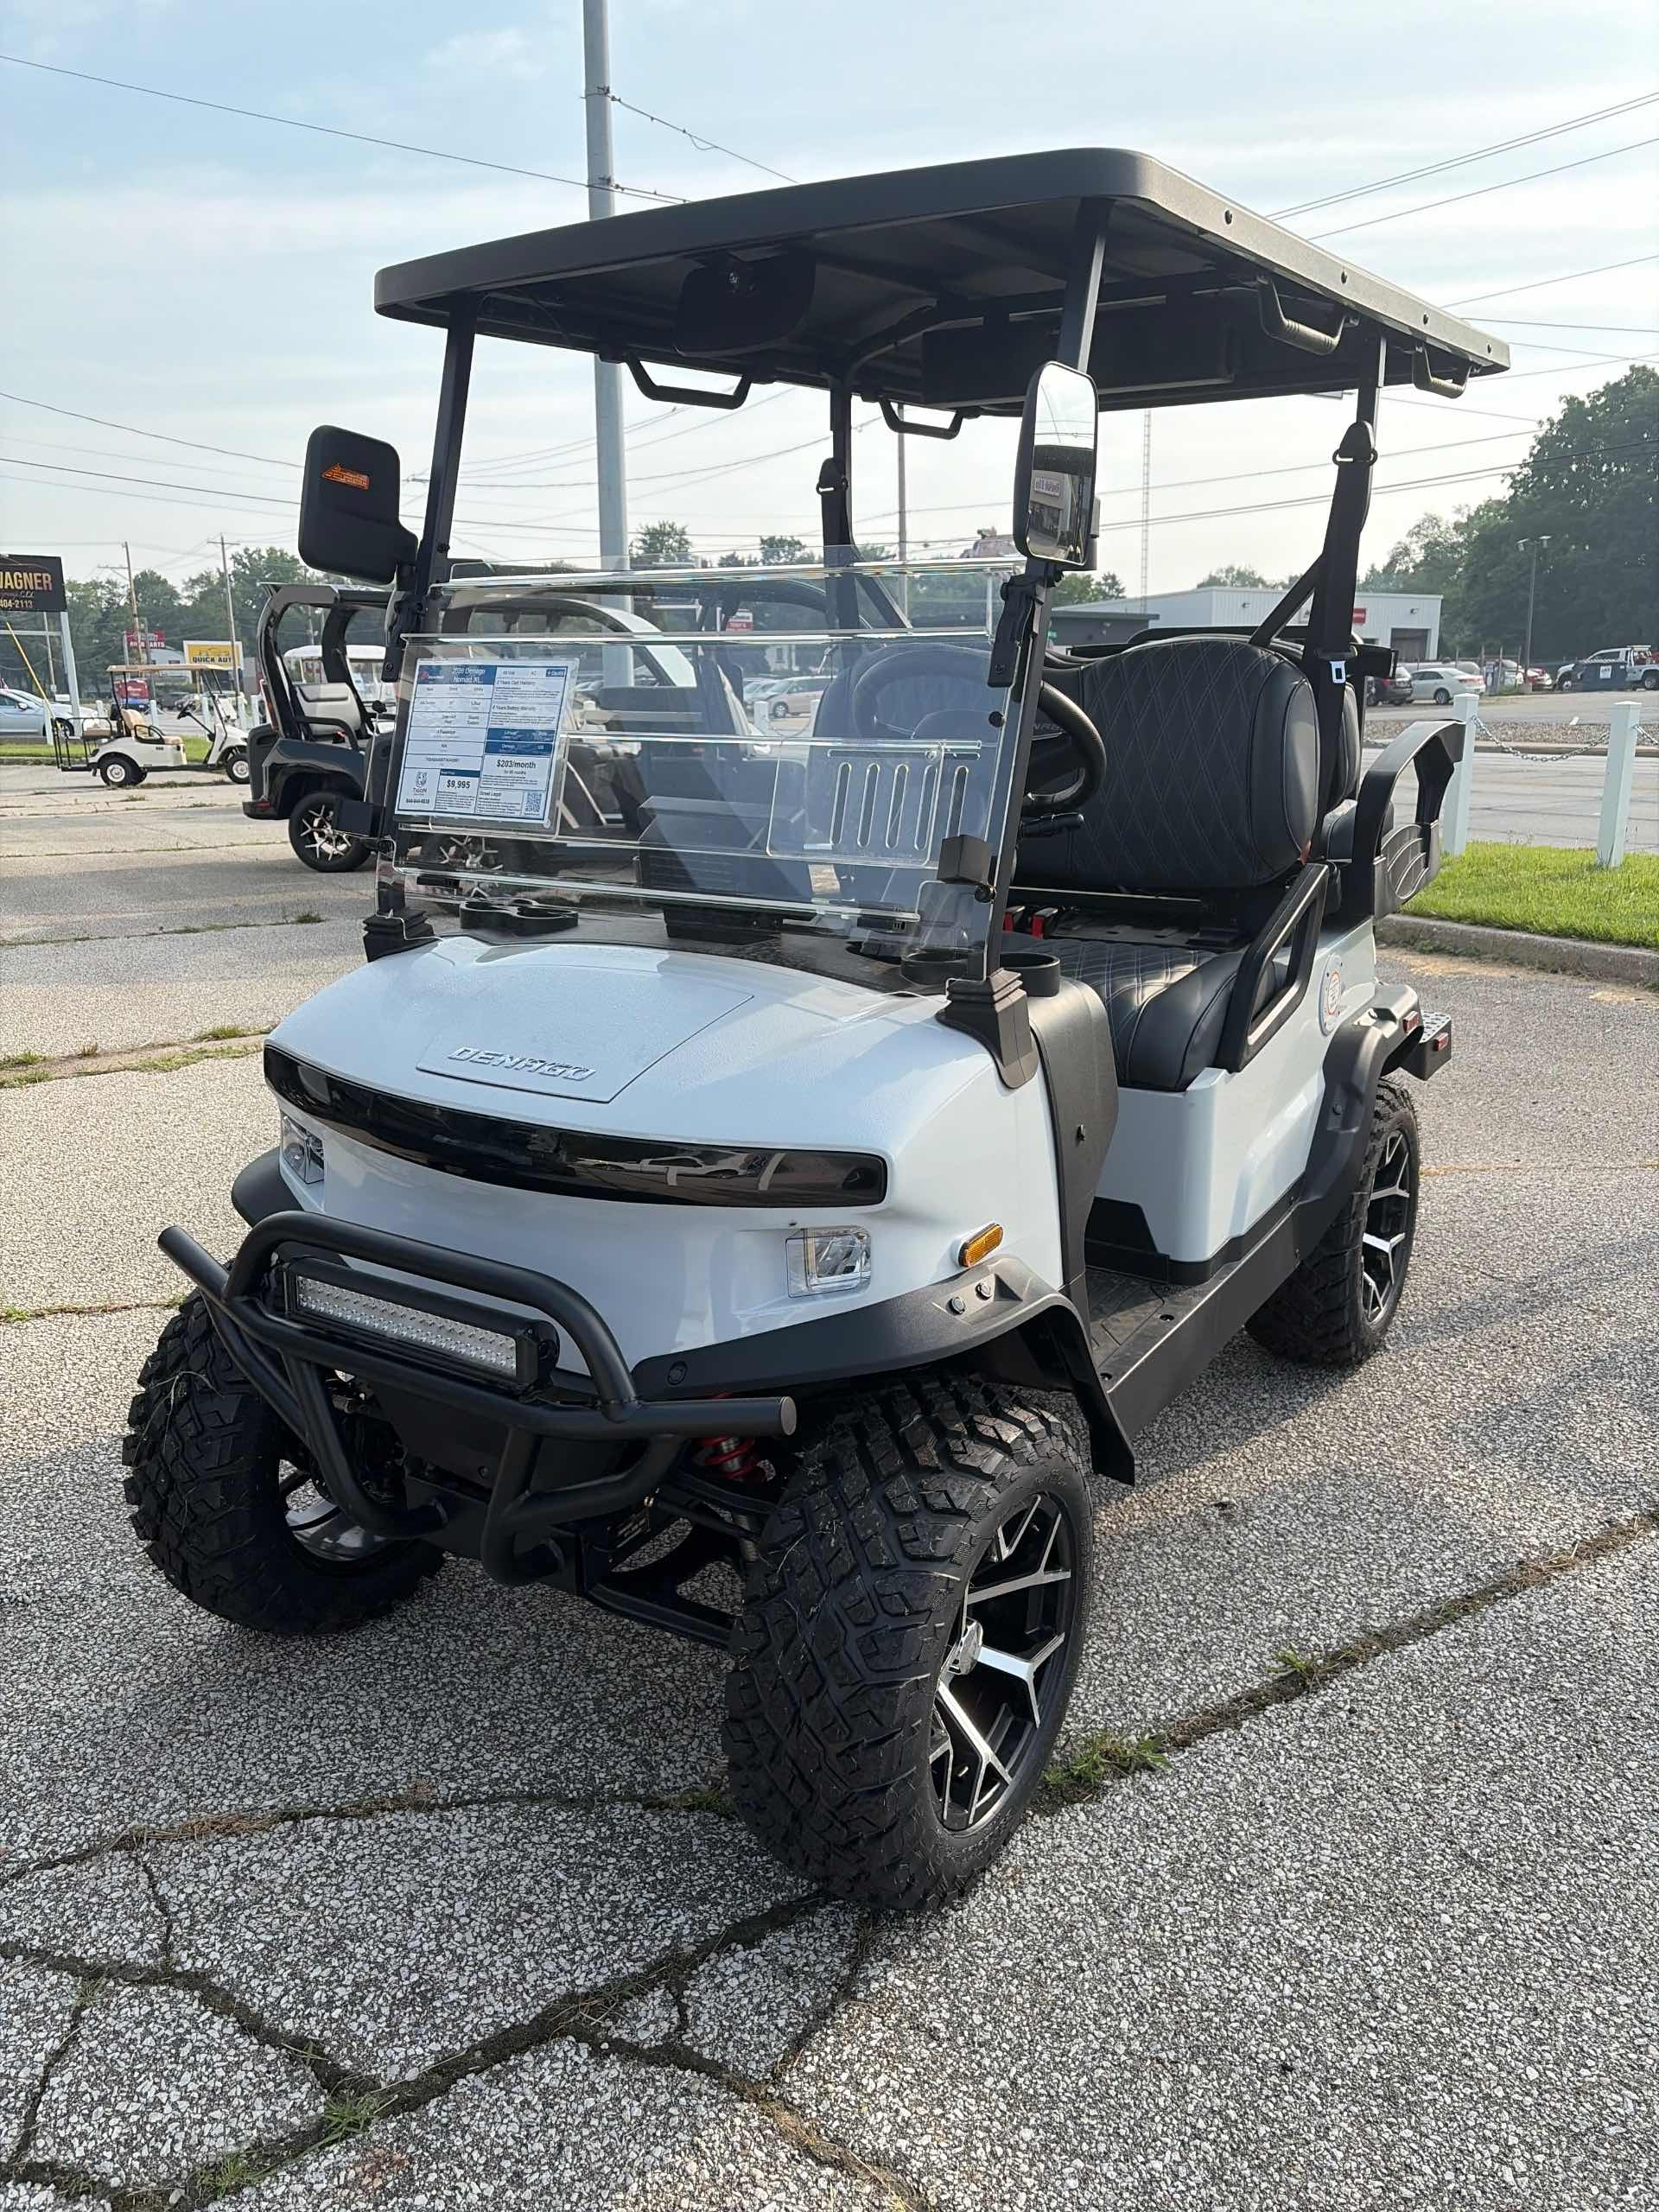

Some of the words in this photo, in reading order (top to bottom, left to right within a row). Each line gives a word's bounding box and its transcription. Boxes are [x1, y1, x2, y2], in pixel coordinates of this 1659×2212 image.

[497, 760, 537, 769] $203/month
[447, 779, 470, 789] $9,995
[447, 1046, 596, 1081] DENAGO
